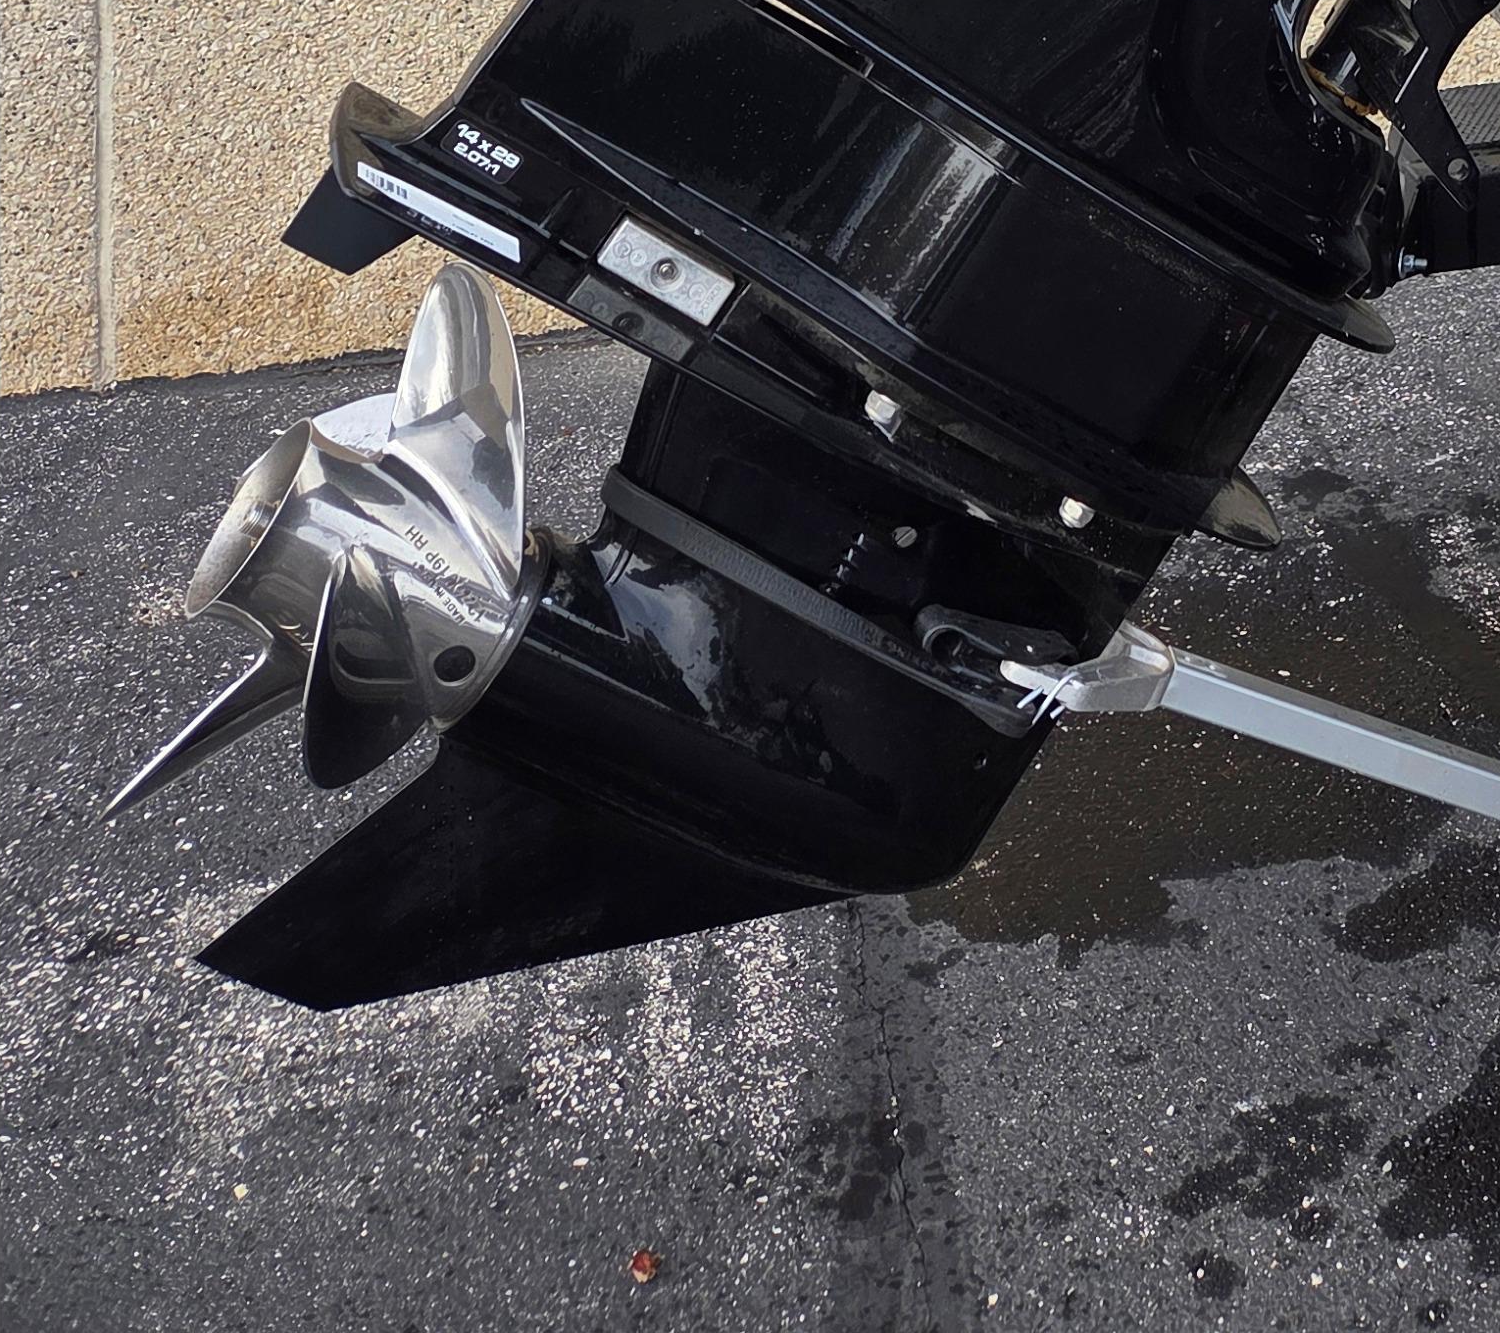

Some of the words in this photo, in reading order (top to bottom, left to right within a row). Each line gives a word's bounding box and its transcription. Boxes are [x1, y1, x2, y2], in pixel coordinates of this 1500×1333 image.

[457, 123, 481, 144] 14
[477, 139, 492, 153] x
[404, 524, 429, 551] RH
